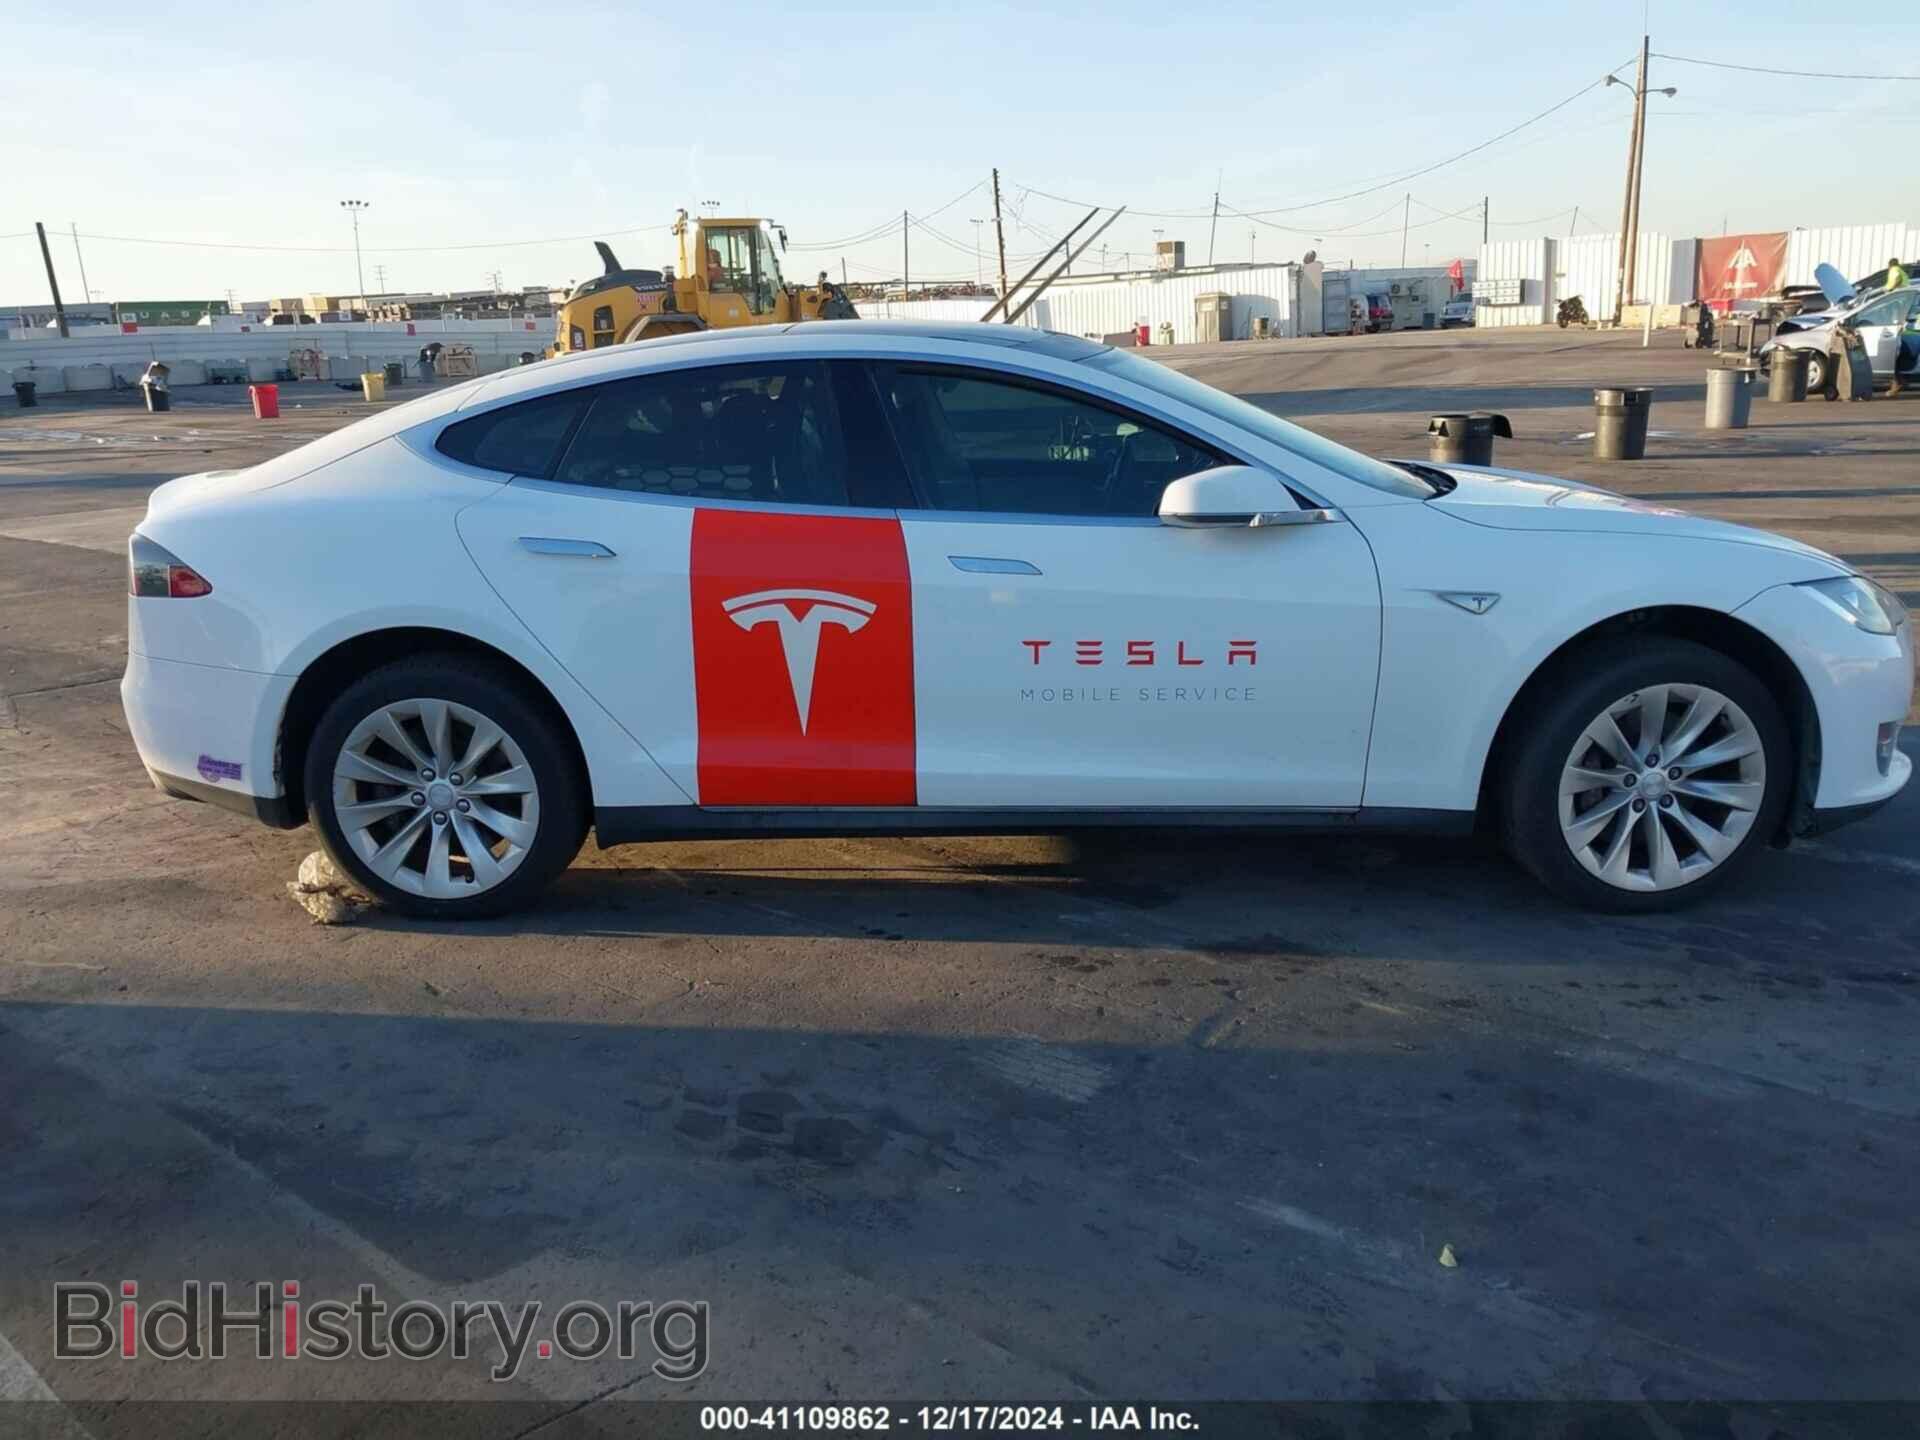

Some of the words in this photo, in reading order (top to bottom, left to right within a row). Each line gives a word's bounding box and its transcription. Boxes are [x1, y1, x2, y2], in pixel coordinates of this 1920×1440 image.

[1021, 641, 1257, 665] TESLA
[1020, 688, 1121, 701] MOBILE
[1139, 687, 1257, 701] SERVICE
